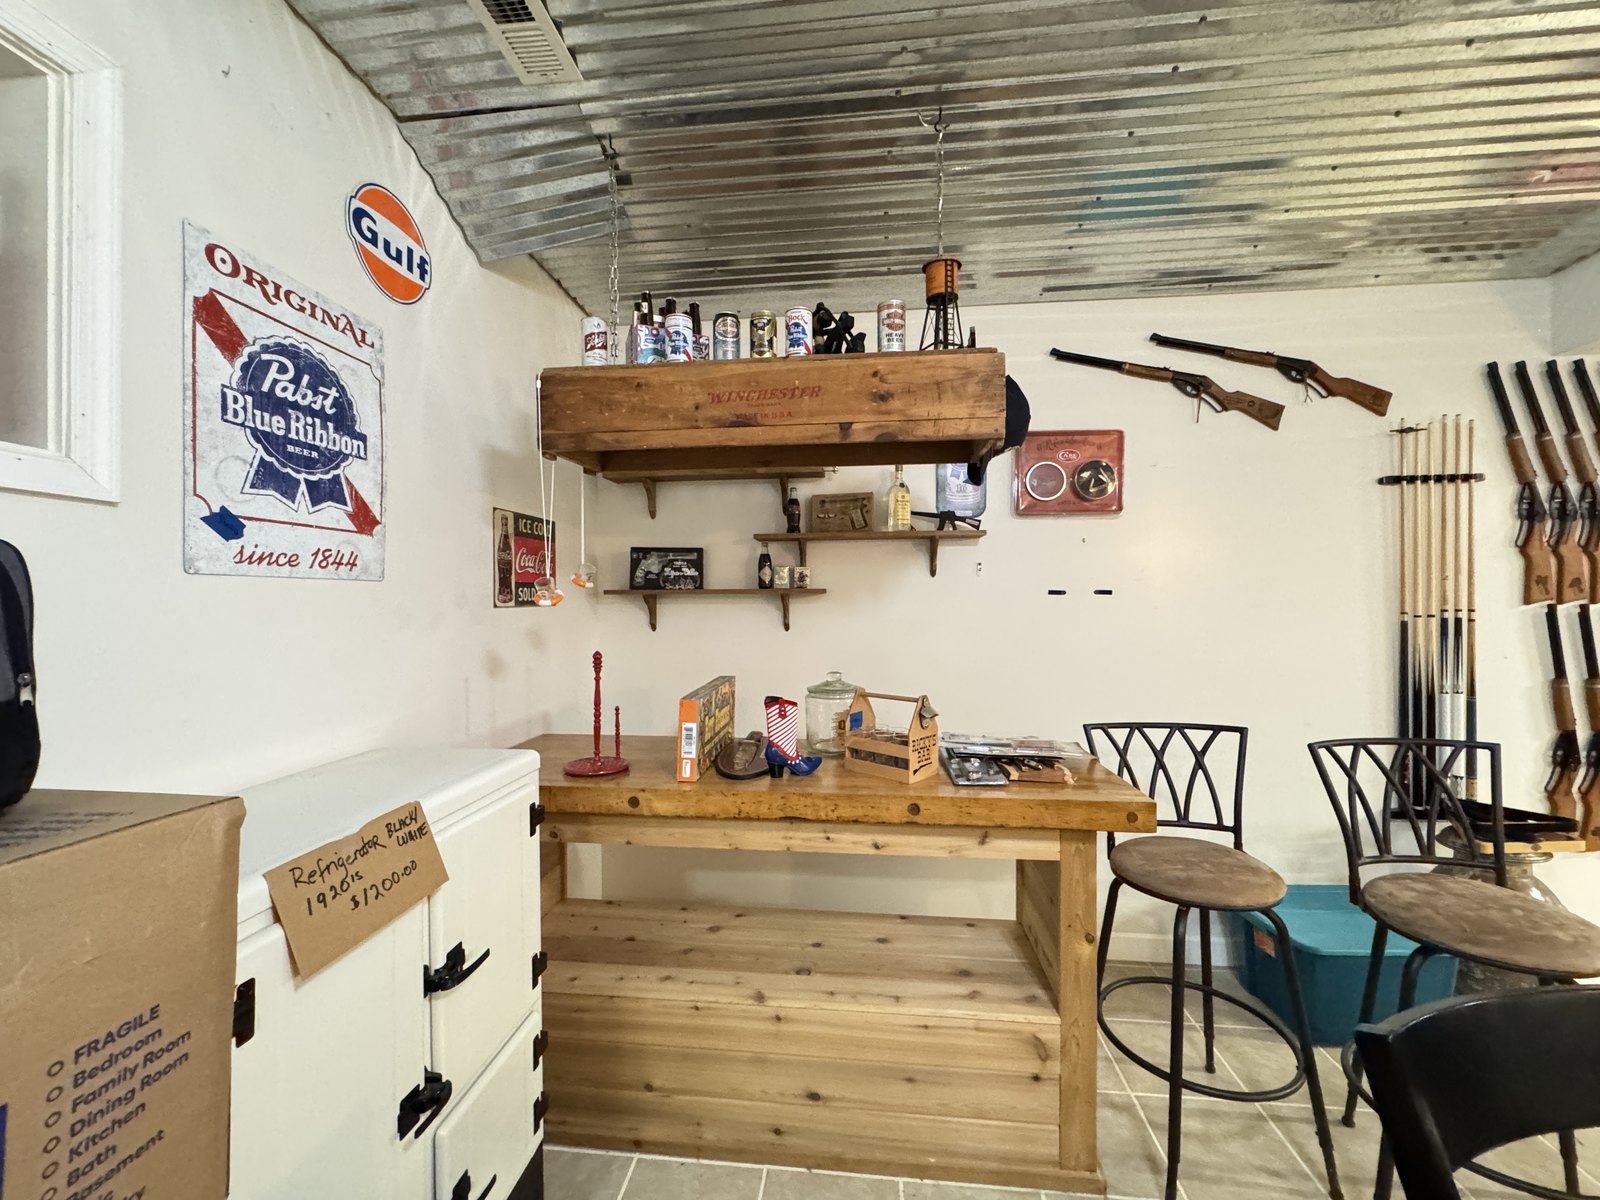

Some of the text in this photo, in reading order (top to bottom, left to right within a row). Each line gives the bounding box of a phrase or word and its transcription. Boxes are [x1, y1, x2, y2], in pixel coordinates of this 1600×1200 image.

[352, 206, 428, 283] Gulf
[205, 243, 375, 349] ORIGINAL
[260, 353, 339, 414] Pabst
[708, 385, 821, 404] WINCHESTER
[223, 387, 367, 459] Blue Ribbon
[286, 445, 319, 459] BEER
[232, 543, 358, 572] since 1844
[519, 518, 551, 538] ICE COD
[918, 748, 931, 763] BAR
[396, 822, 428, 847] WHITE
[350, 860, 417, 910] $1200.00
[72, 1029, 162, 1089] Bedroom
[74, 1004, 160, 1064] FRAGILE
[69, 1052, 189, 1138] Dining Room
[71, 1031, 191, 1114] Family Room
[68, 1102, 146, 1163] Kitchen
[67, 1144, 117, 1187] Bath
